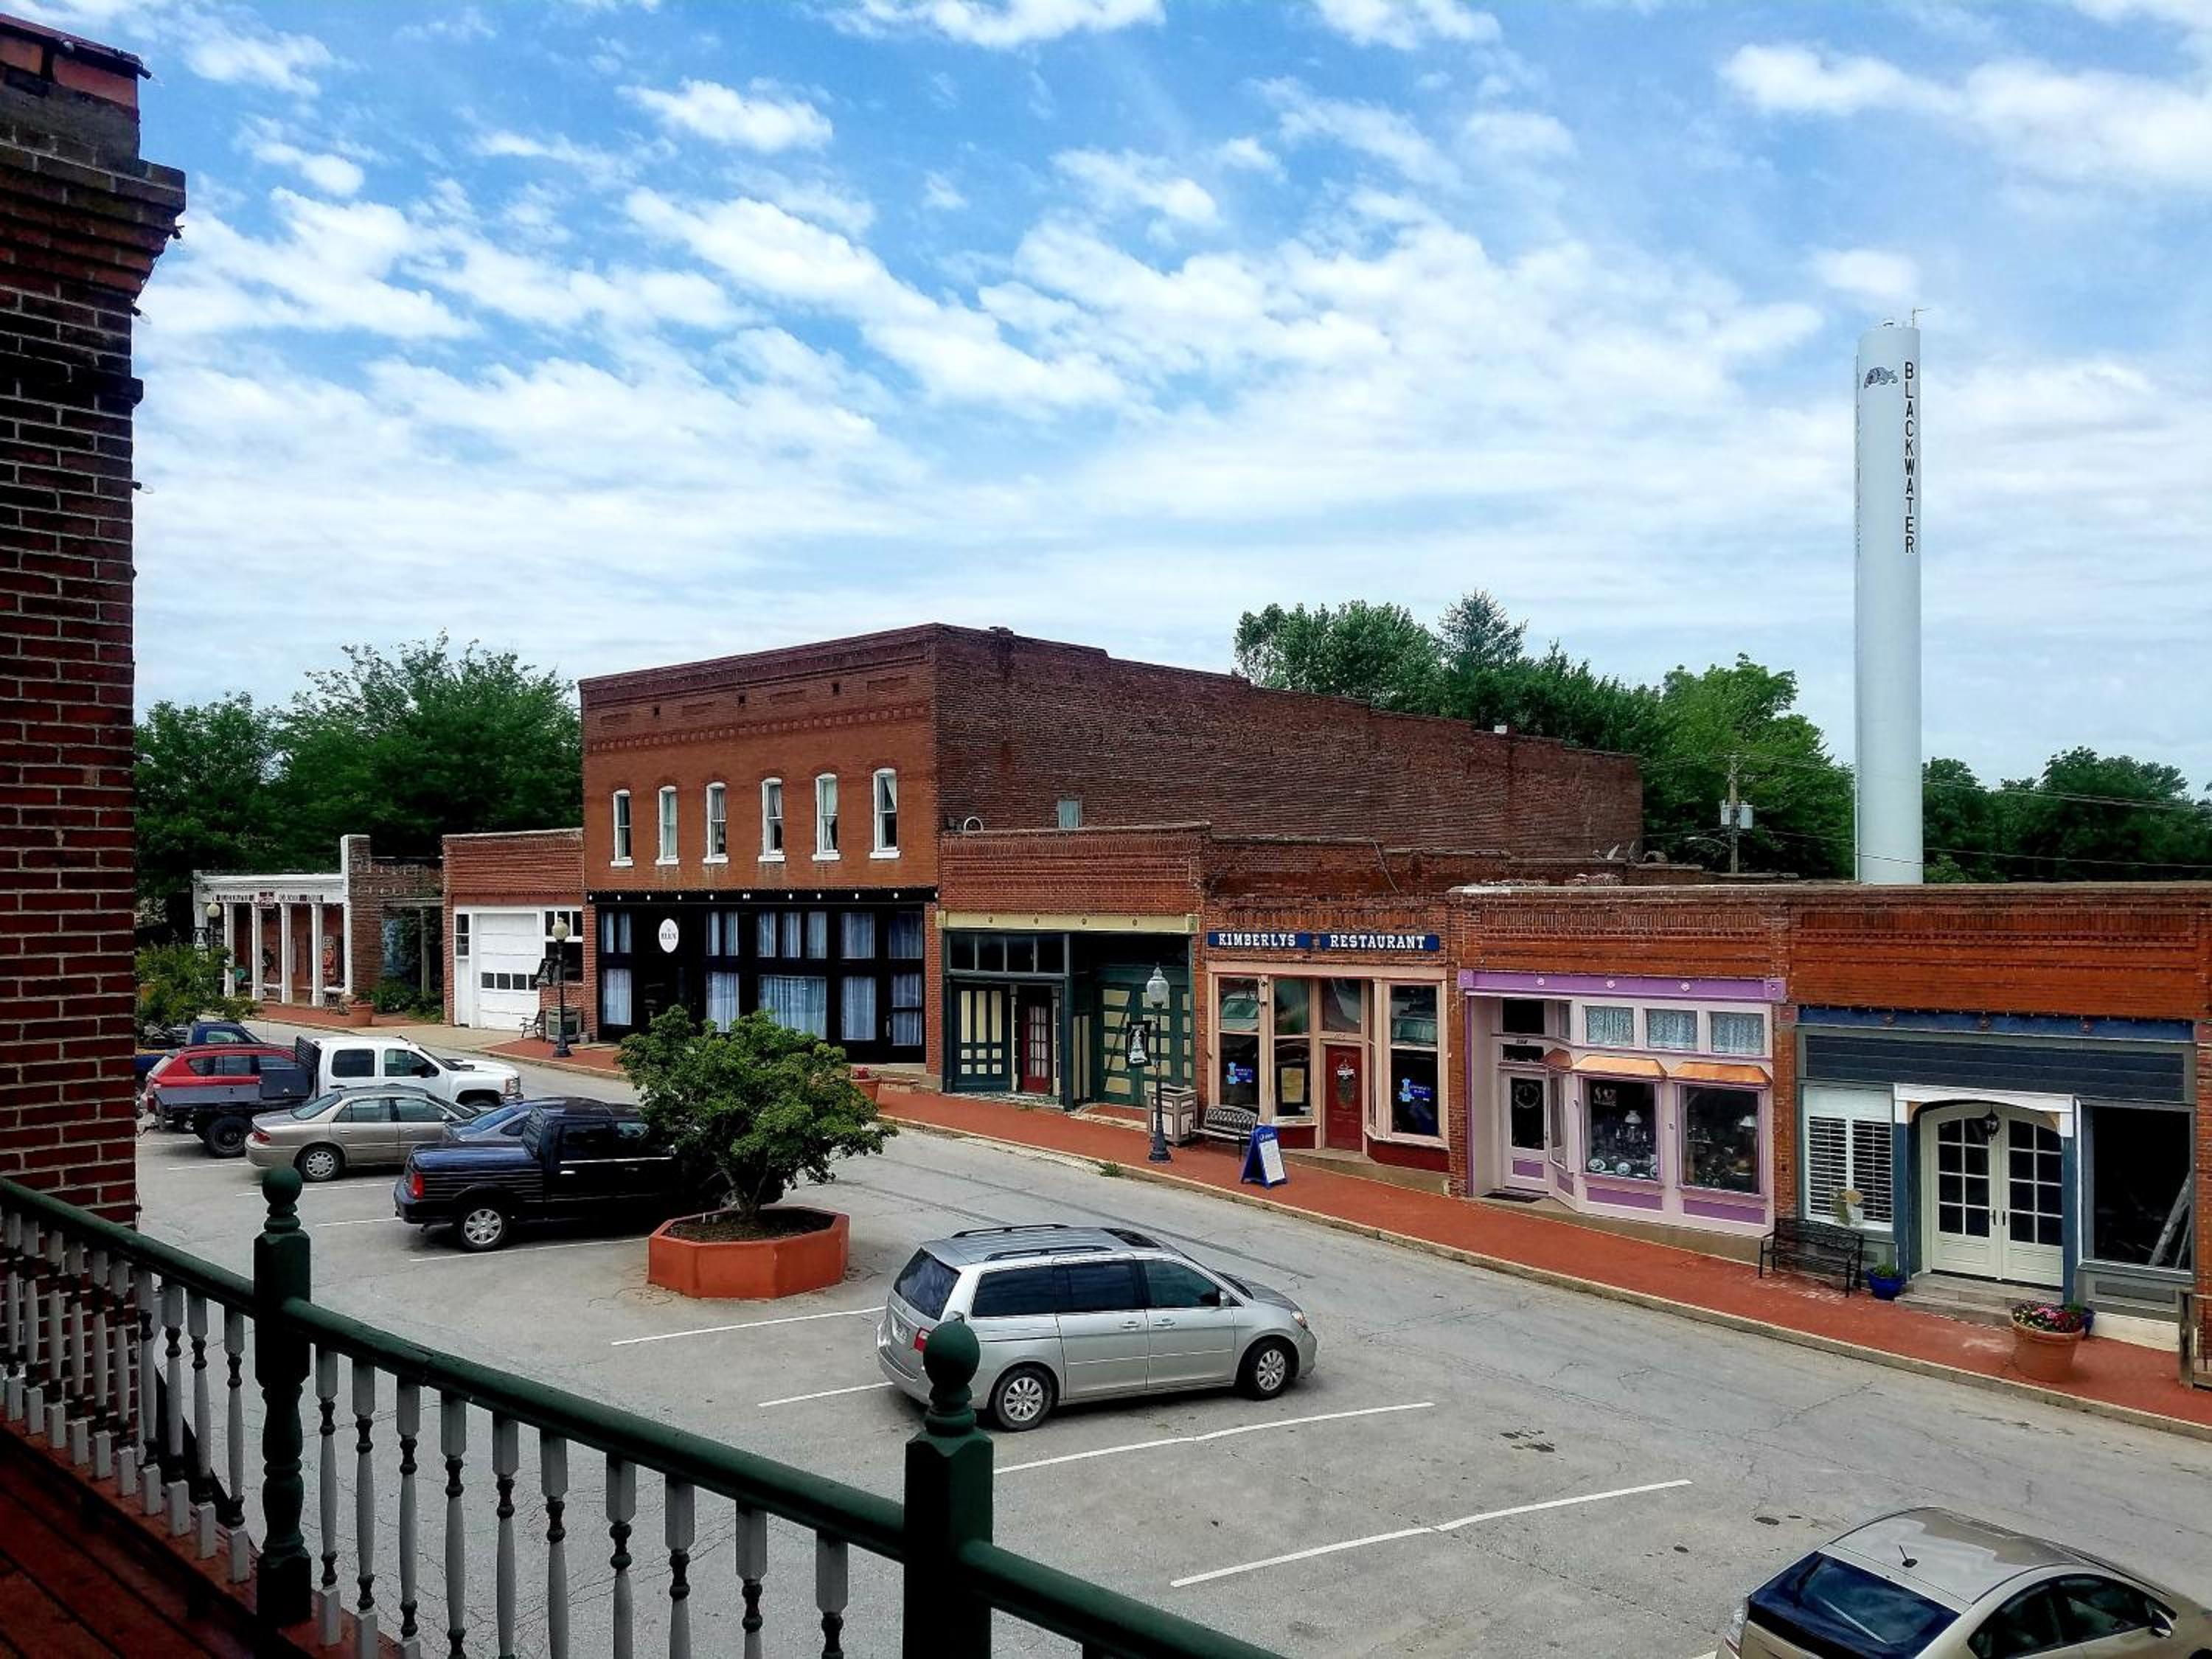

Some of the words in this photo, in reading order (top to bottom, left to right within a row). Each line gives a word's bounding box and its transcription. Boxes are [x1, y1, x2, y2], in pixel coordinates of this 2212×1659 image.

[1905, 361, 1915, 554] BLACKWATER
[1219, 933, 1295, 947] KIMBERLYS
[1329, 934, 1425, 949] RESTAURANT
